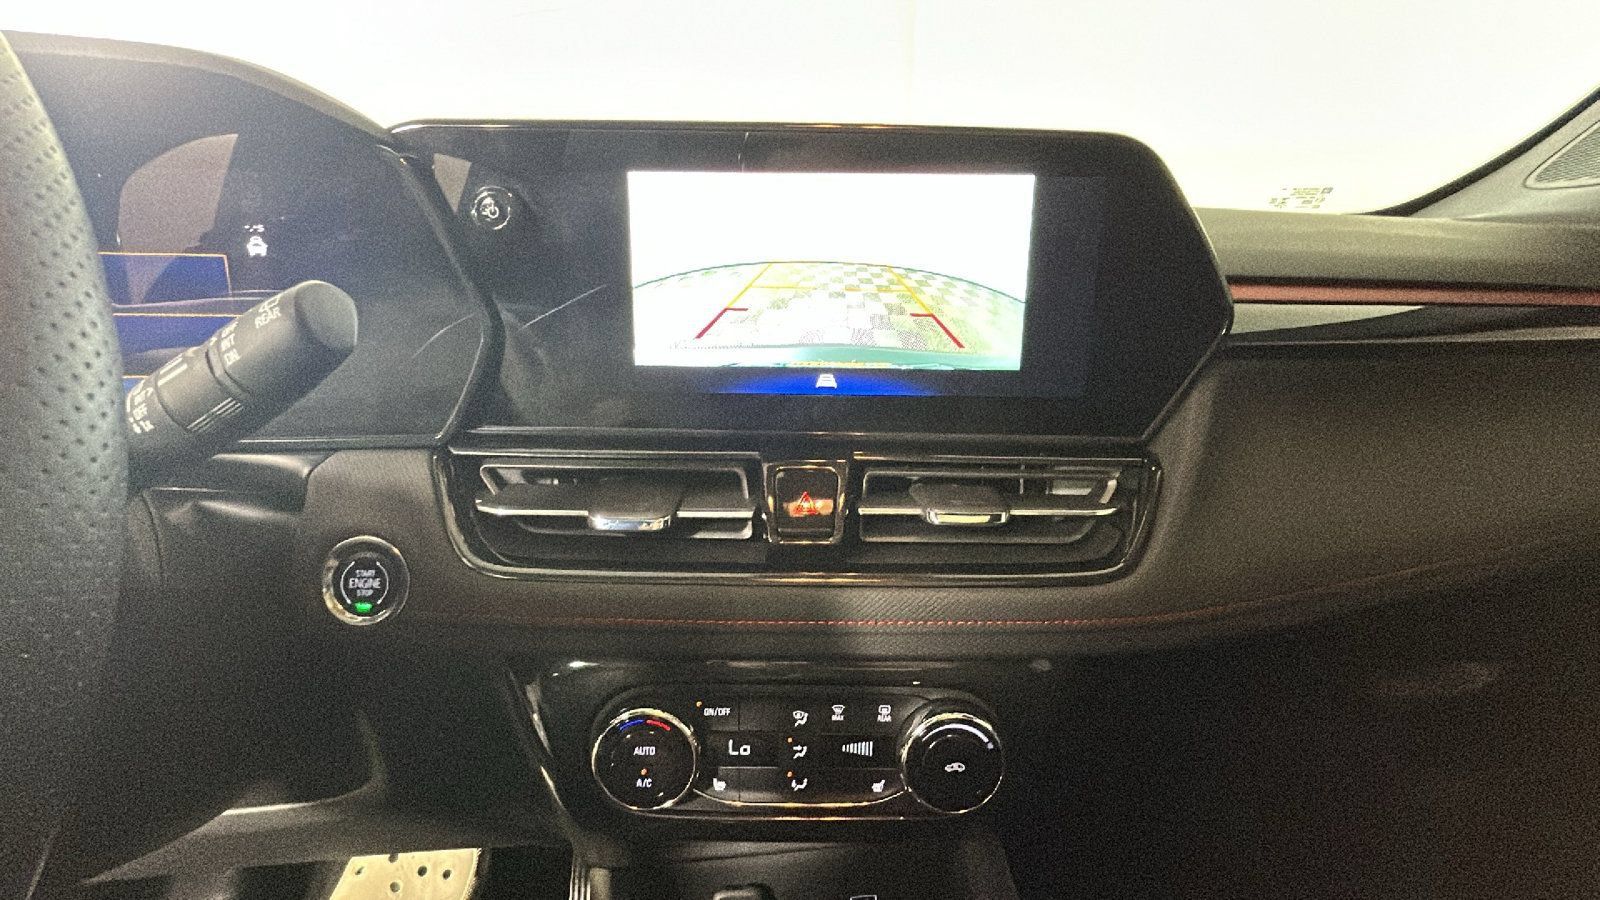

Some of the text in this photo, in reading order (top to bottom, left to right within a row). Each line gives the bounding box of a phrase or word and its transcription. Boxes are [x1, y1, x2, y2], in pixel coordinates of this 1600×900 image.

[254, 306, 282, 329] REAR
[348, 577, 382, 589] ENGINE
[703, 706, 731, 717] ON/OFF
[632, 745, 656, 756] AUTO
[635, 777, 653, 789] A/C
